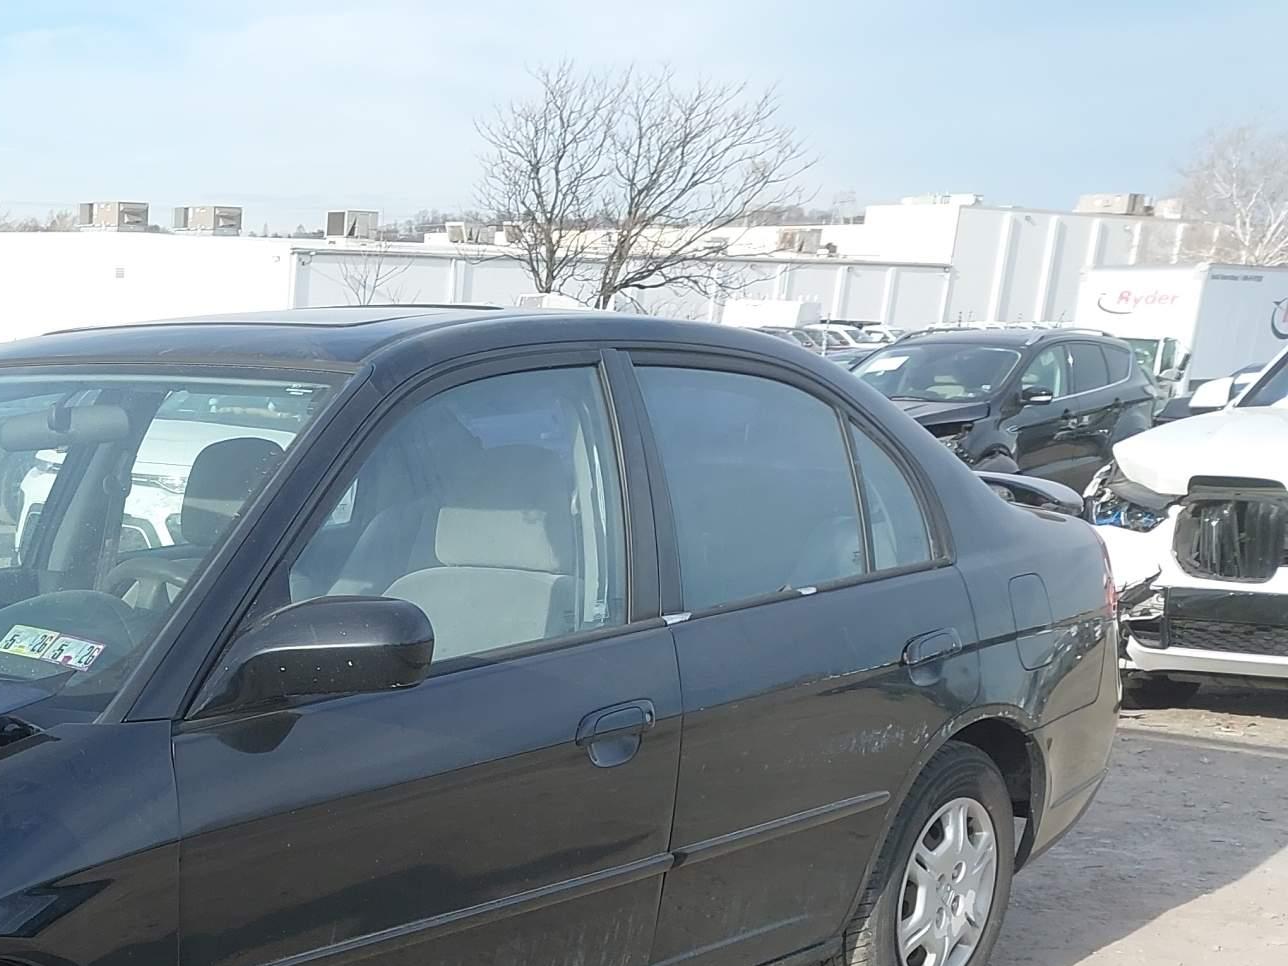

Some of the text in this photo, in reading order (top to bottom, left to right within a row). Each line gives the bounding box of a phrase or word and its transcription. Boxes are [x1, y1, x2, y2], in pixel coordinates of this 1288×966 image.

[1115, 290, 1180, 309] Ryder
[4, 633, 54, 654] 5 26
[51, 643, 101, 666] 5 26
